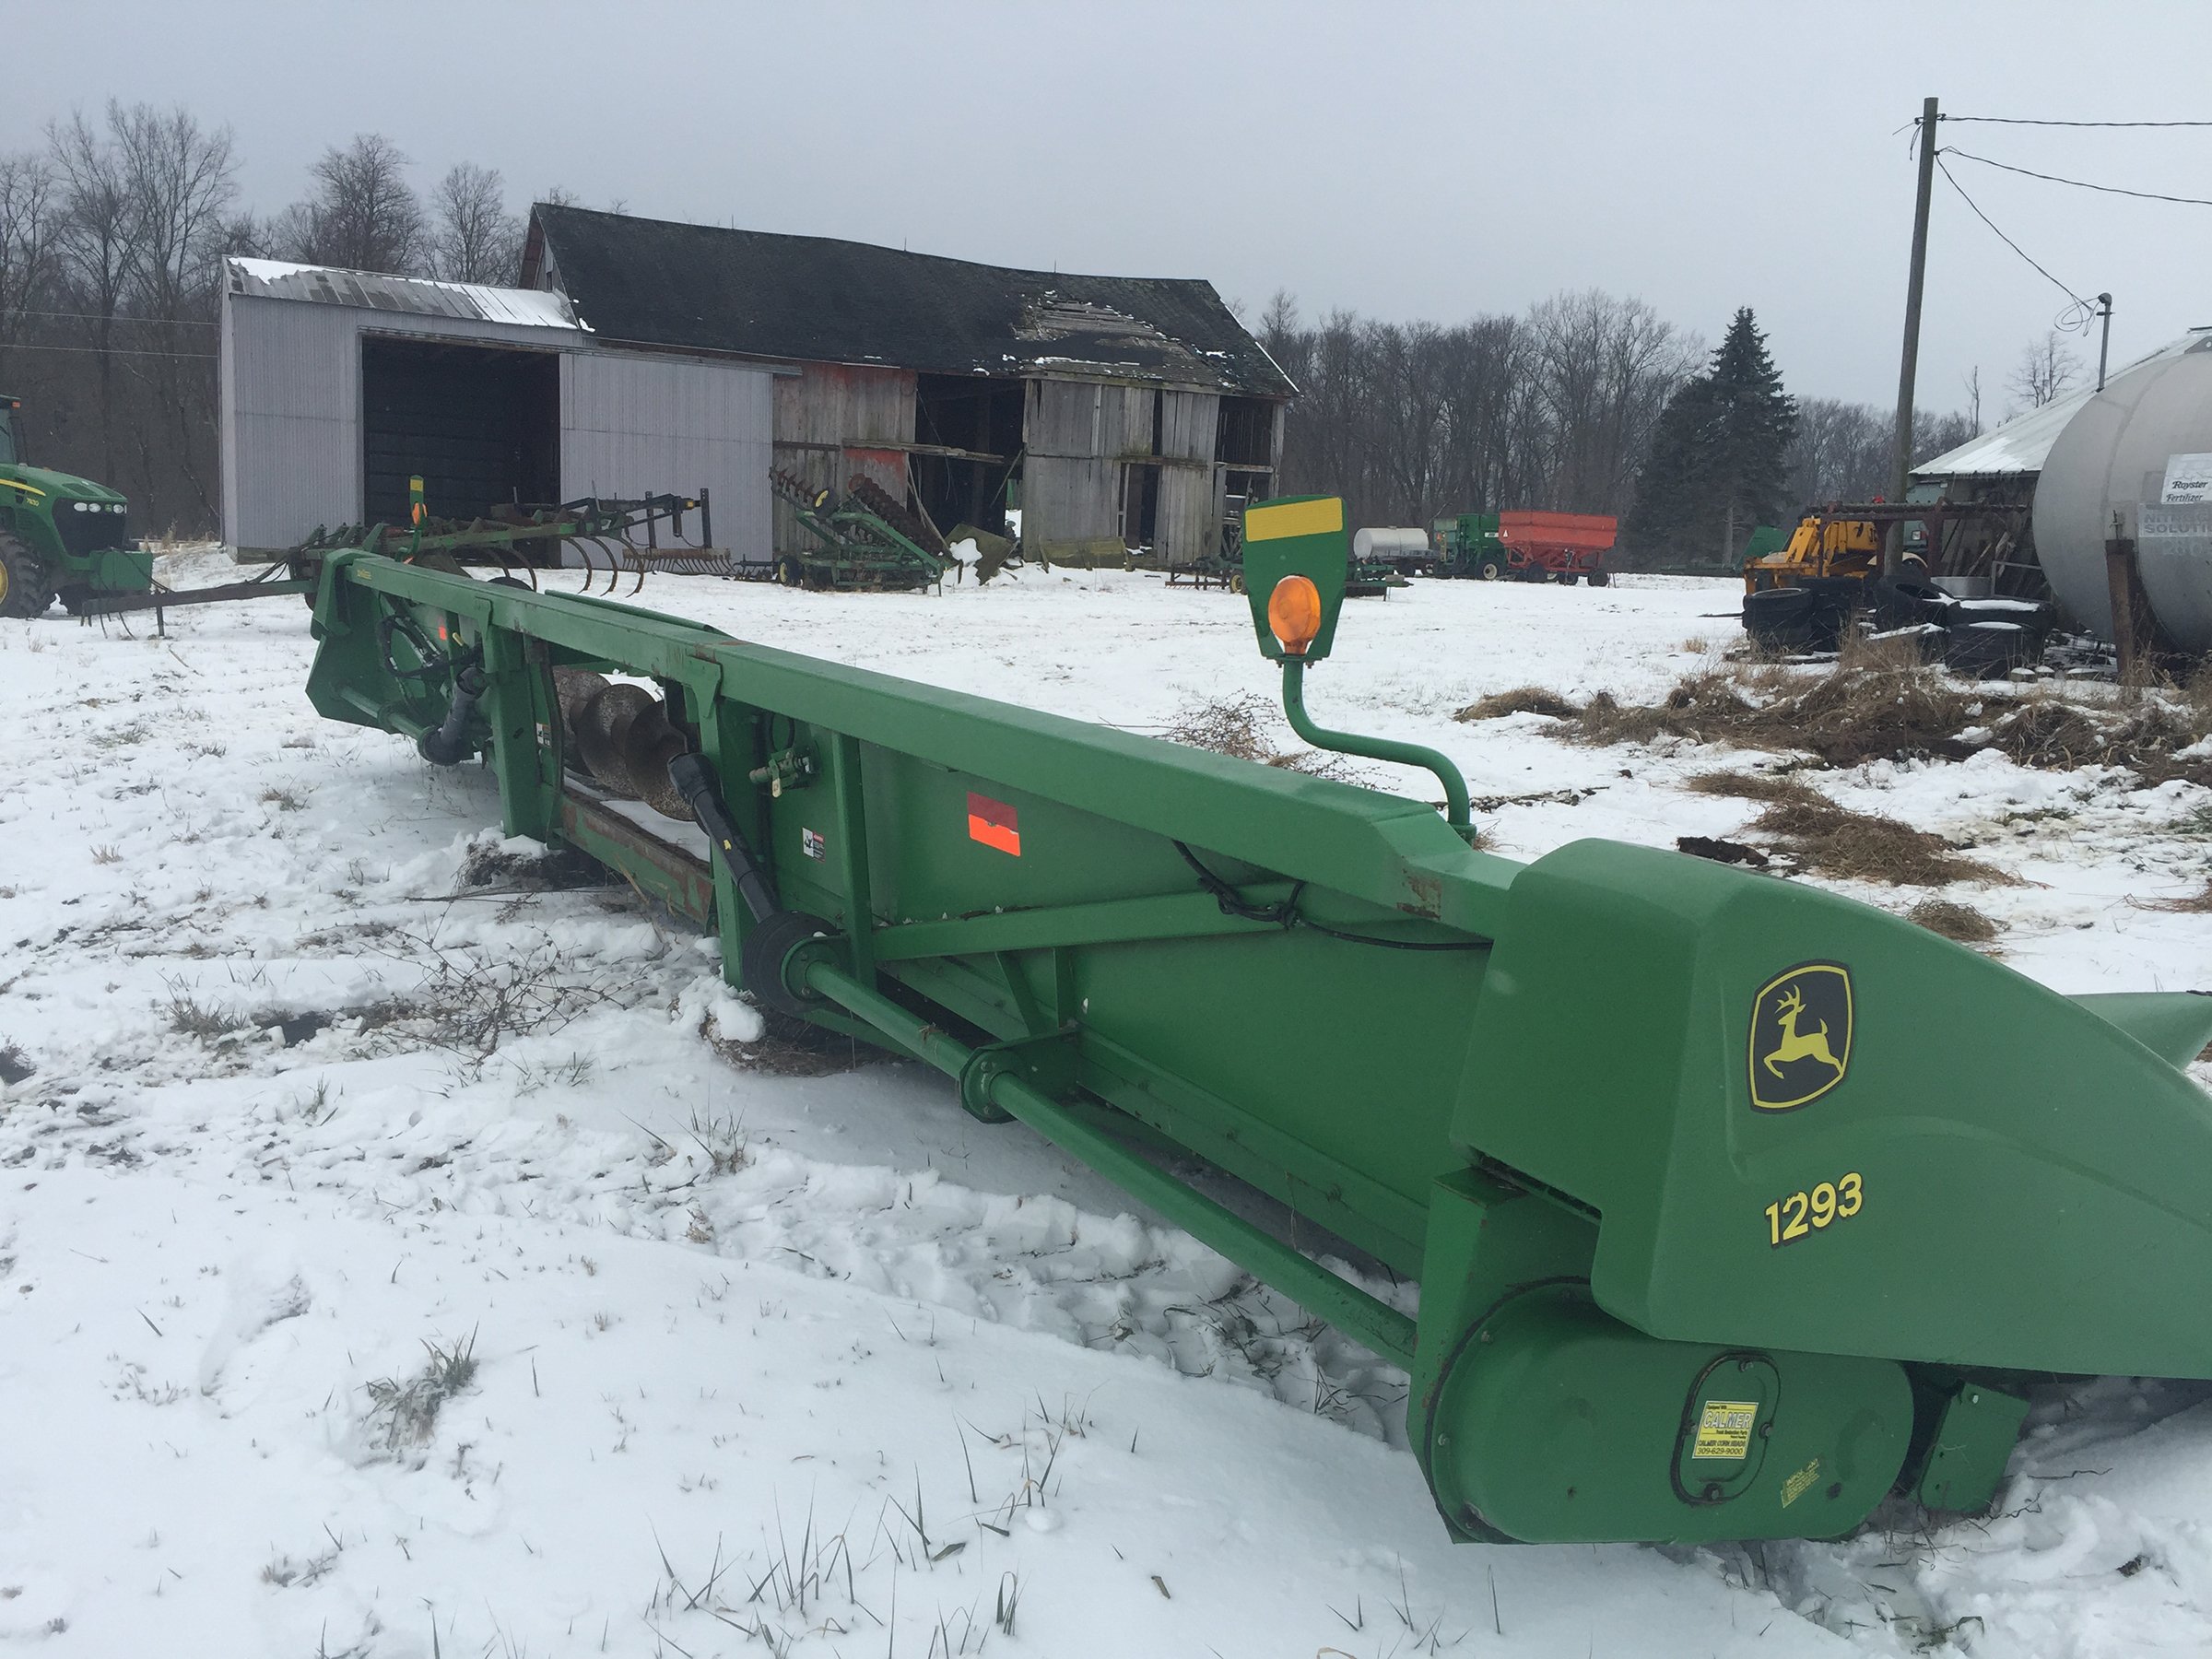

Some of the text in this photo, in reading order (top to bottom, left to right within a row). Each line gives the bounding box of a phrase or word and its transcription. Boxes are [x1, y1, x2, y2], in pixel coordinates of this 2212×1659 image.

[2172, 480, 2208, 490] Royster
[2166, 493, 2204, 502] Fertilizer
[1765, 1171, 1863, 1246] 1293
[1703, 1411, 1753, 1430] CALMER
[1697, 1447, 1744, 1455] 309-629-9000
